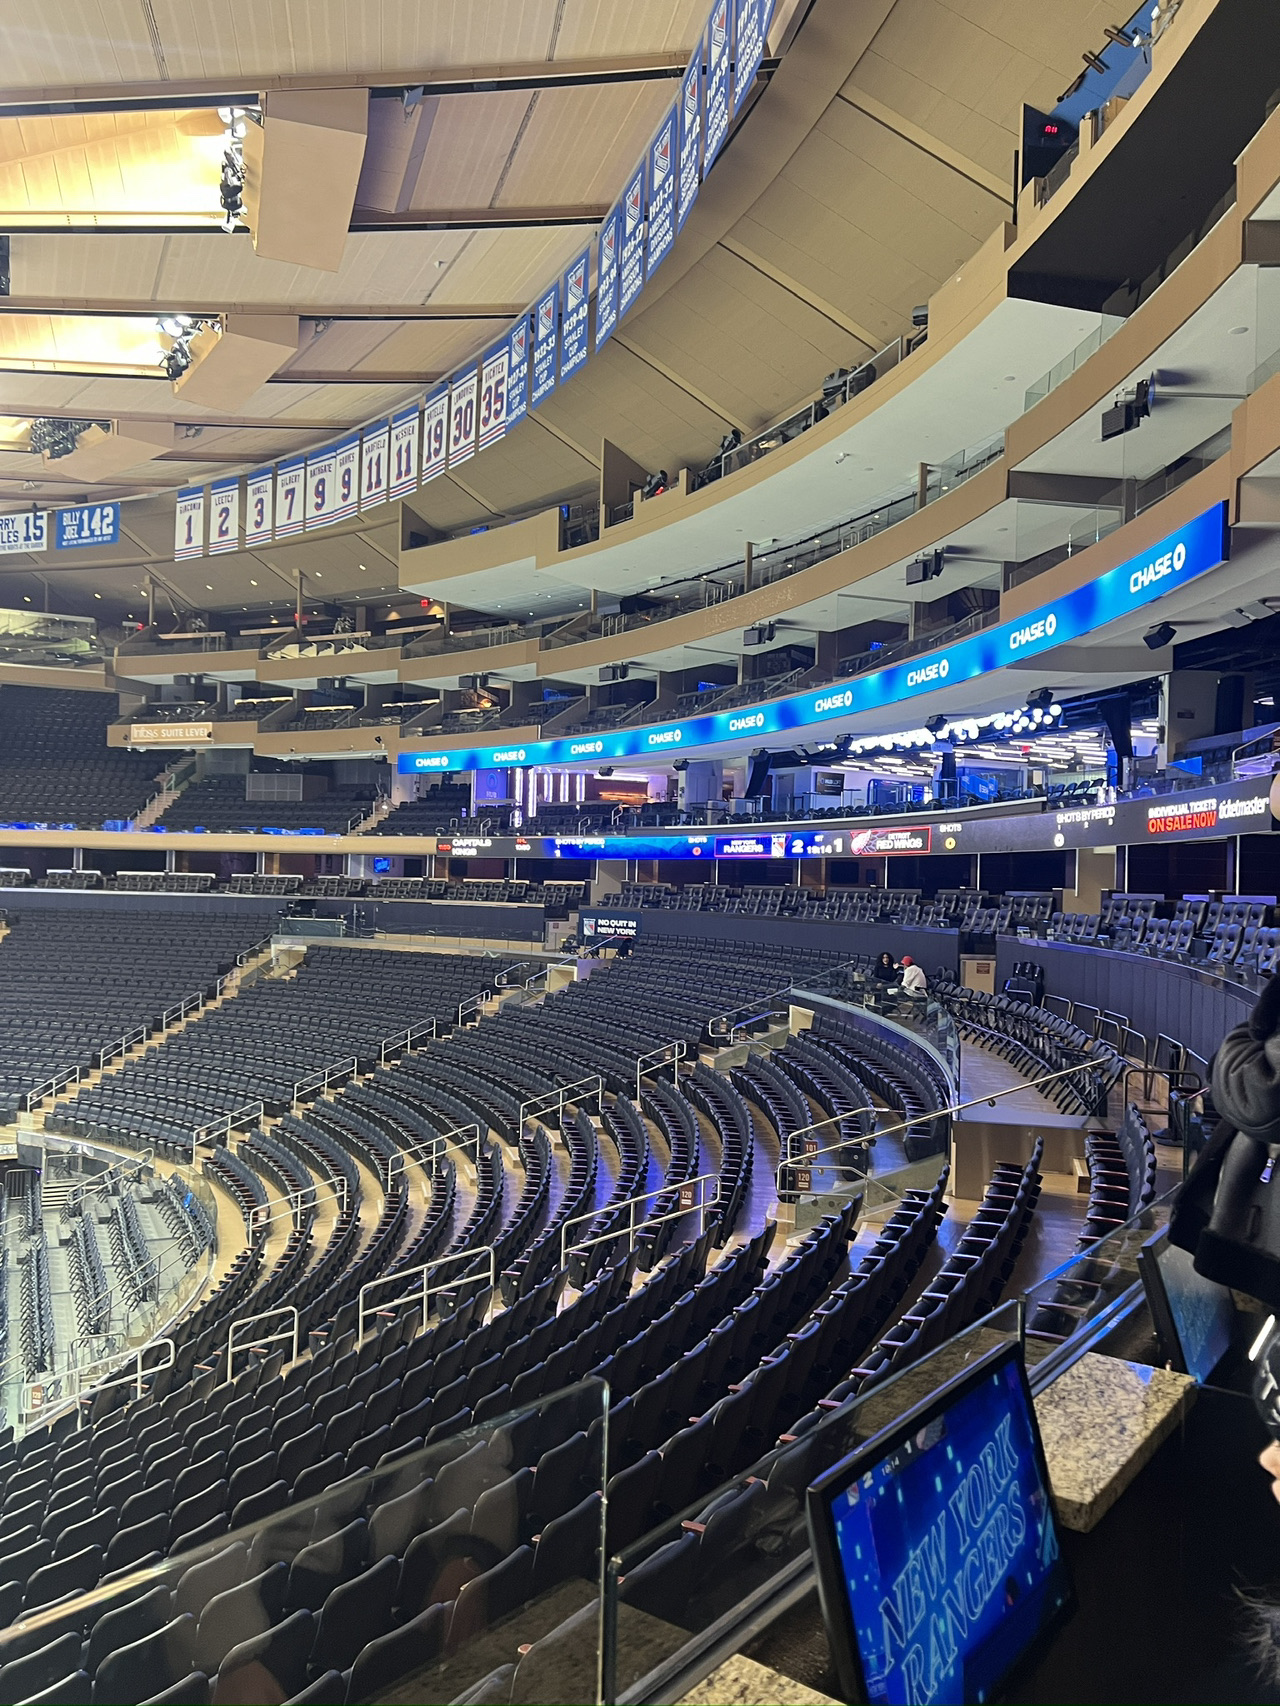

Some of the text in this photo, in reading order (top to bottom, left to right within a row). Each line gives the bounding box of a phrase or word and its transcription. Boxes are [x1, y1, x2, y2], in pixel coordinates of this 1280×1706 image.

[564, 323, 584, 350] STANLEY
[568, 341, 579, 358] CUP
[560, 346, 587, 377] CHAMPIONS
[538, 369, 548, 385] CUP
[481, 375, 506, 428] 35
[453, 398, 474, 447] 30
[425, 418, 444, 464] 19
[395, 440, 412, 481] 11
[281, 474, 301, 488] GILBERT
[366, 453, 383, 493] 11
[341, 467, 352, 502] 9
[314, 477, 326, 512] 9
[284, 487, 296, 520] 7
[62, 511, 80, 526] BILLY
[253, 497, 265, 529] 3
[24, 514, 44, 542] 15
[81, 506, 114, 537] 142
[185, 514, 193, 545] 1
[217, 506, 230, 538] 2
[62, 525, 79, 540] JOEL
[1129, 552, 1172, 594] CHASE
[1009, 619, 1046, 649] CHASE
[907, 664, 939, 686] CHASE
[815, 697, 844, 713] CHASE
[161, 728, 184, 738] SUITE
[186, 726, 208, 737] LEVEL
[729, 718, 756, 731] CHASE
[649, 733, 673, 744] CHASE
[493, 751, 518, 762] CHASE
[571, 744, 595, 755] CHASE
[416, 758, 441, 768] CHASE
[1057, 806, 1116, 823] SHOTS BY PERIOD
[1148, 799, 1217, 819] INDIVIDUAL TICKETS
[940, 824, 962, 833] SHOTS
[1149, 811, 1217, 833] ON SALE NOW
[452, 838, 492, 847] CAPITALS
[723, 844, 764, 853] RANGERS
[792, 839, 803, 854] 2
[834, 838, 843, 853] 1
[876, 838, 923, 850] RED WINGS
[945, 838, 956, 850] 0
[1054, 833, 1065, 848] 0
[452, 847, 477, 856] KINGS
[610, 919, 627, 928] QUIT
[628, 920, 637, 928] IN
[616, 928, 637, 936] YORK
[805, 1142, 817, 1153] 101
[797, 1172, 810, 1182] 120
[681, 1190, 692, 1200] 120
[862, 1470, 874, 1489] 2
[904, 1440, 912, 1454] 1
[879, 1412, 1019, 1676] NEW YORK
[901, 1480, 1028, 1706] RANGERS
